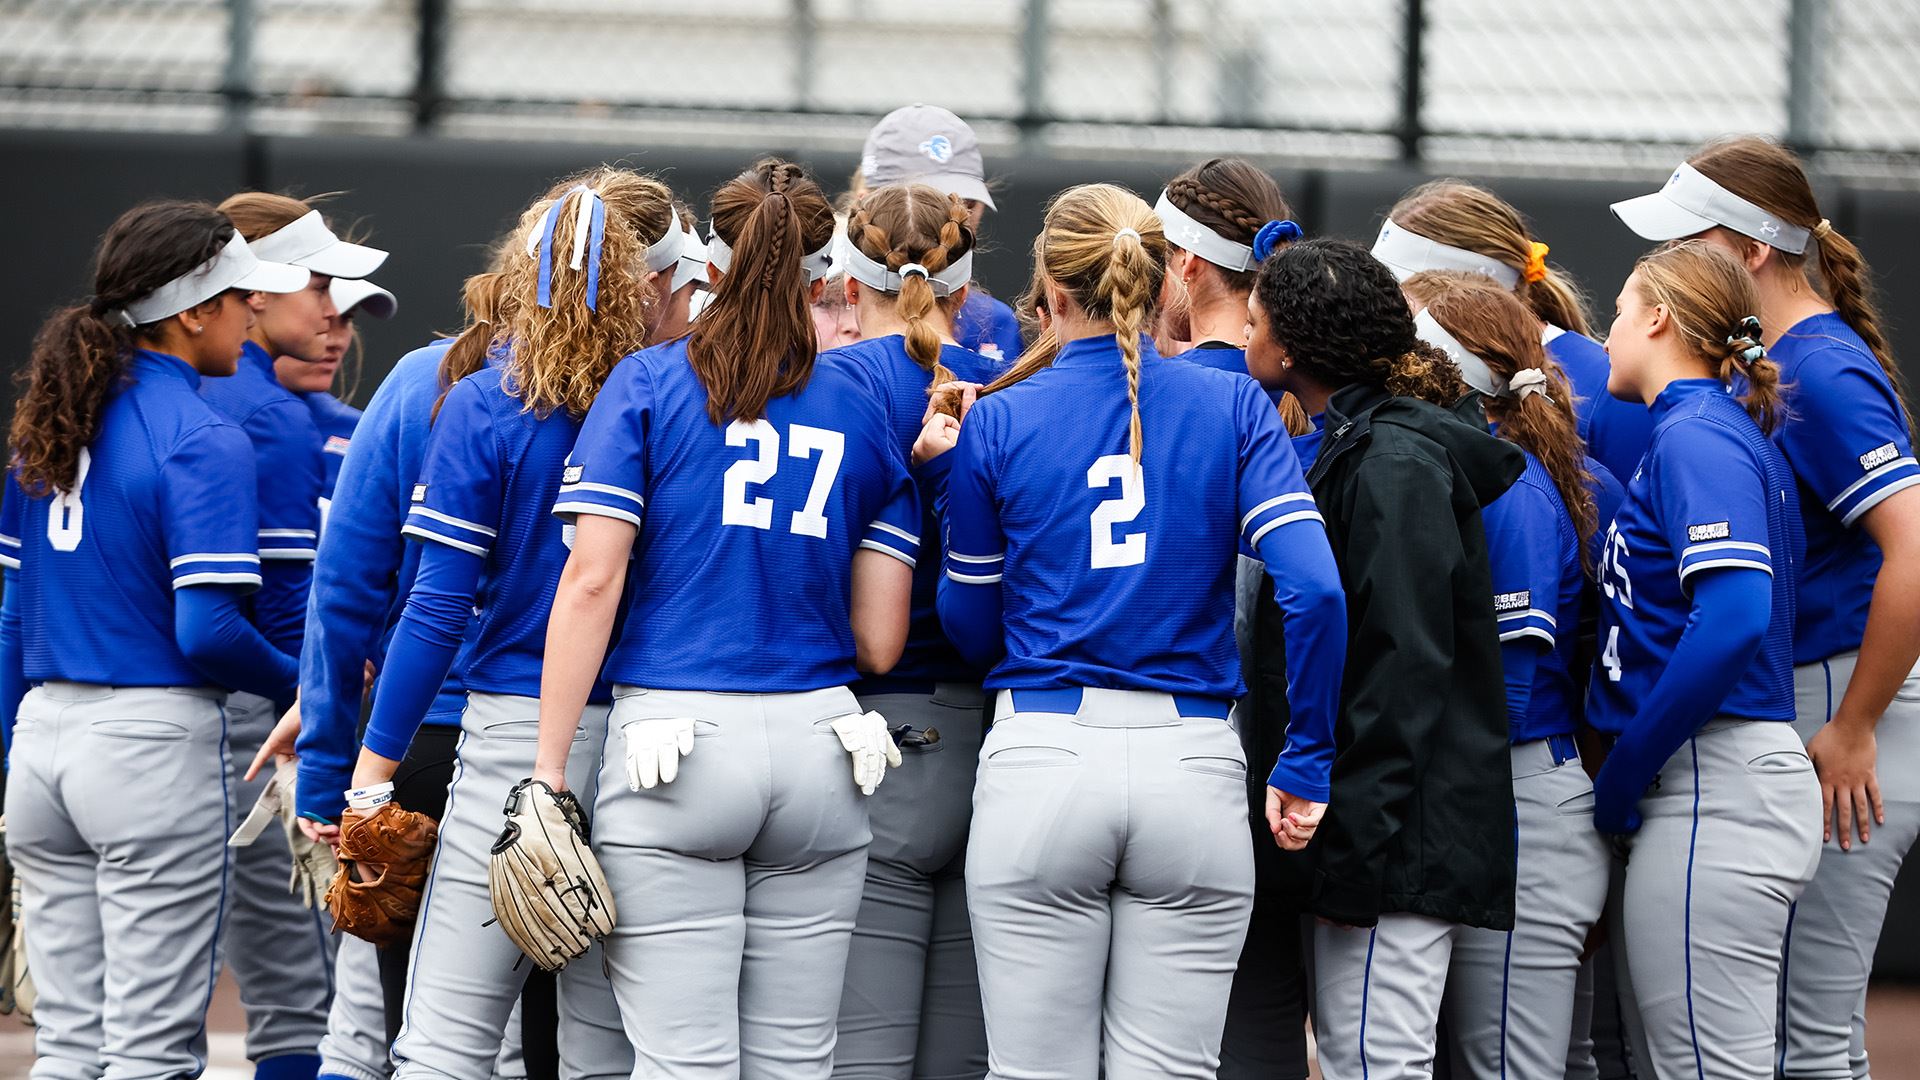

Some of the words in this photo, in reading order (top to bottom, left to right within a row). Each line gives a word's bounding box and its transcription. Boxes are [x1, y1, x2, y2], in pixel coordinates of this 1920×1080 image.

[722, 418, 845, 539] 27
[1087, 454, 1146, 569] 2
[1690, 529, 1729, 541] CHANGE
[1500, 593, 1517, 603] BE
